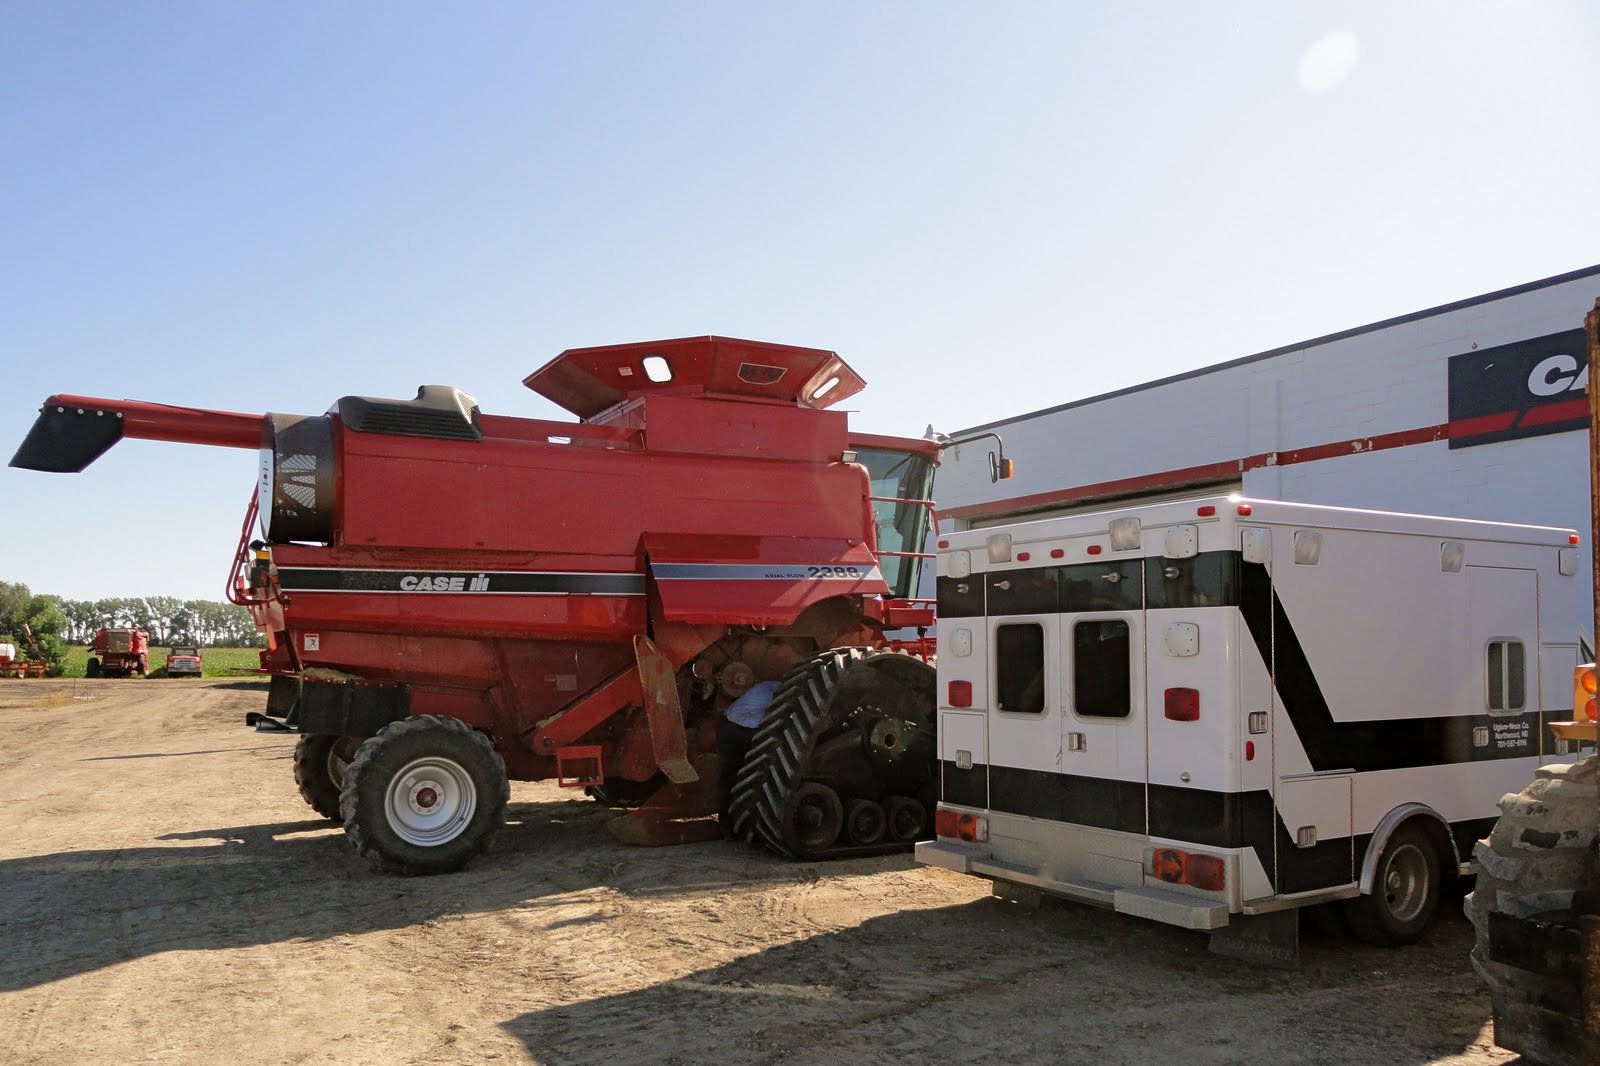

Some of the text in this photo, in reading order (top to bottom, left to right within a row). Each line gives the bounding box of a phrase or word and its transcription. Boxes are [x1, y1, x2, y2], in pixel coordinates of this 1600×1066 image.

[807, 566, 861, 578] 2388
[400, 576, 466, 591] CASE
[1521, 721, 1530, 729] Co.
[1494, 730, 1529, 740] Northwood, ND
